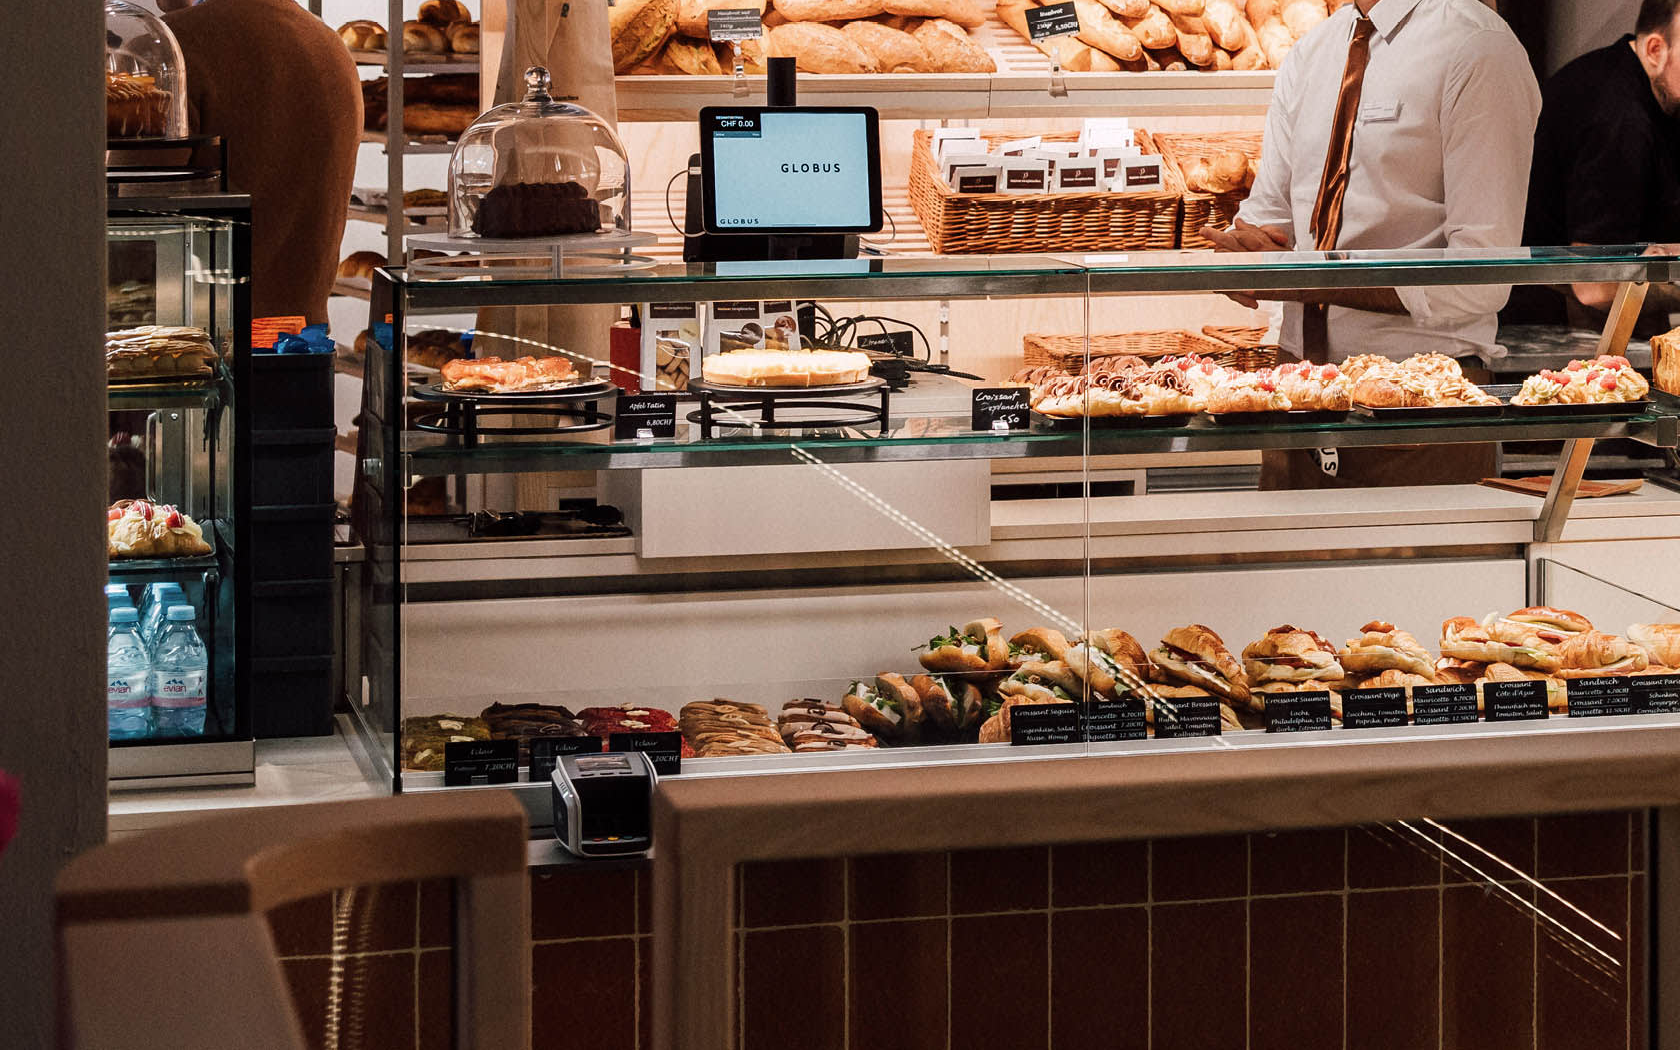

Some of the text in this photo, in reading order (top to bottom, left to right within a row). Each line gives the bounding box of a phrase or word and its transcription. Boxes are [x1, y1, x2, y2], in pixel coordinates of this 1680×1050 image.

[721, 120, 754, 128] CHF 0.00
[781, 163, 841, 173] GLOBUS
[975, 391, 1020, 401] Croissant
[629, 402, 646, 411] Apfel
[1500, 681, 1533, 689] Croissant
[1579, 677, 1619, 687] Sandwich
[1631, 679, 1663, 687] Croissant
[163, 685, 187, 694] evian
[1424, 684, 1466, 694] Sandwich
[1265, 694, 1329, 704] Croissant Saumon
[1349, 692, 1382, 700] Croissant
[1015, 709, 1049, 717] Croissant
